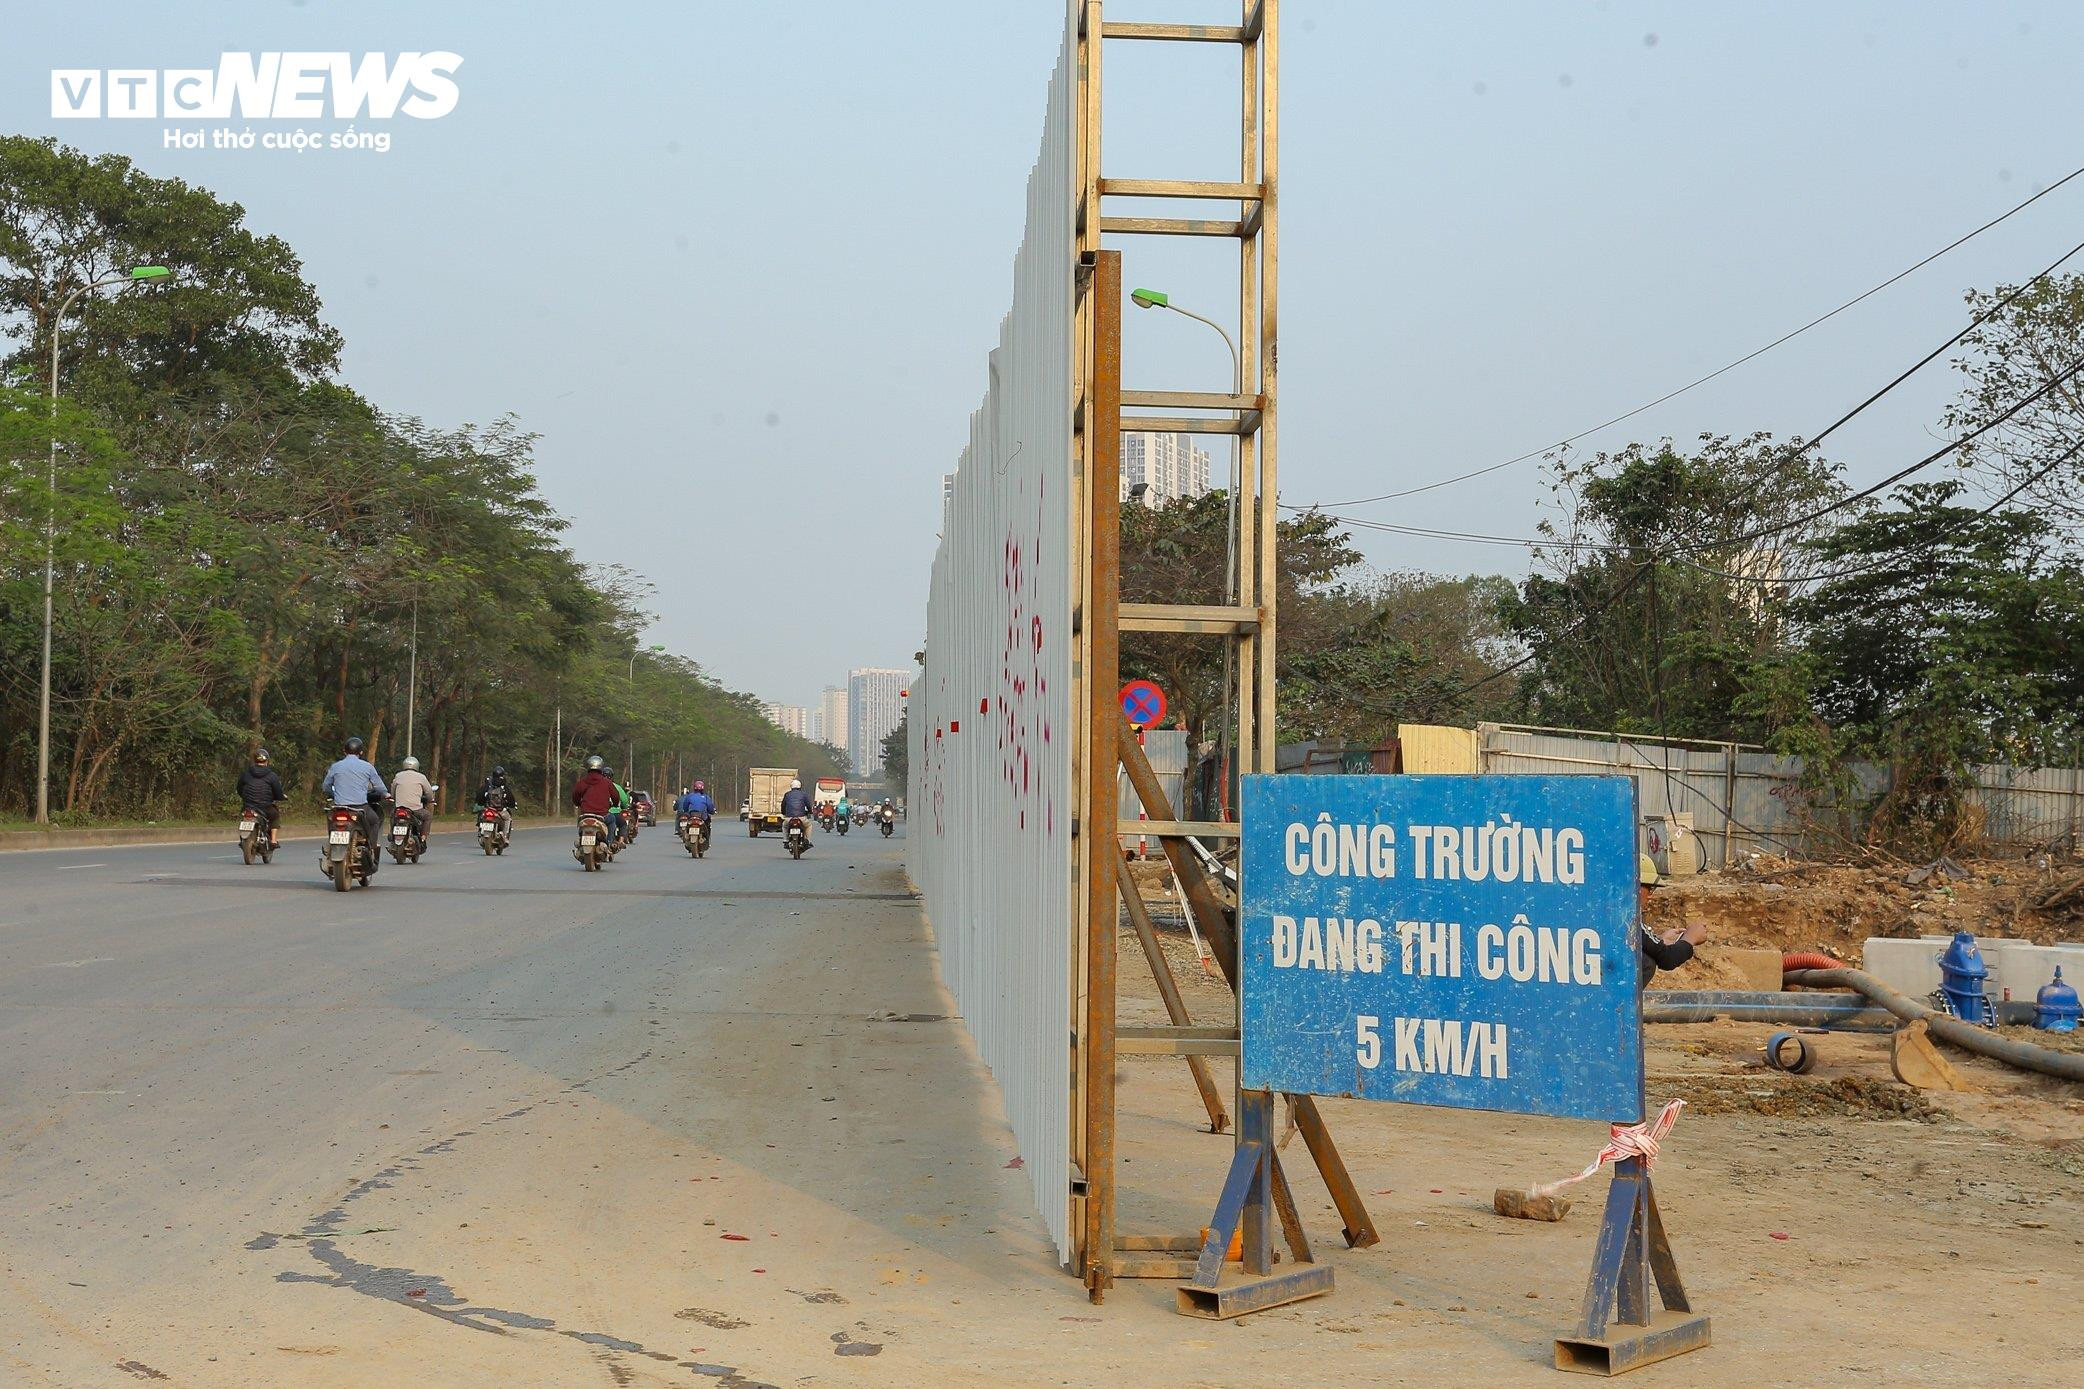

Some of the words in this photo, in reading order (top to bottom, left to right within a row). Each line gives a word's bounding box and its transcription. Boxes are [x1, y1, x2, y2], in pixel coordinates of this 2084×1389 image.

[1285, 812, 1396, 879] CÔNG
[1408, 813, 1585, 885] TRƯỜNG
[1271, 916, 1385, 974] ĐANG
[1395, 920, 1462, 978] THI
[1477, 914, 1602, 986] CÔNG
[1356, 1015, 1381, 1069] 5
[1394, 1017, 1508, 1079] KM/H
